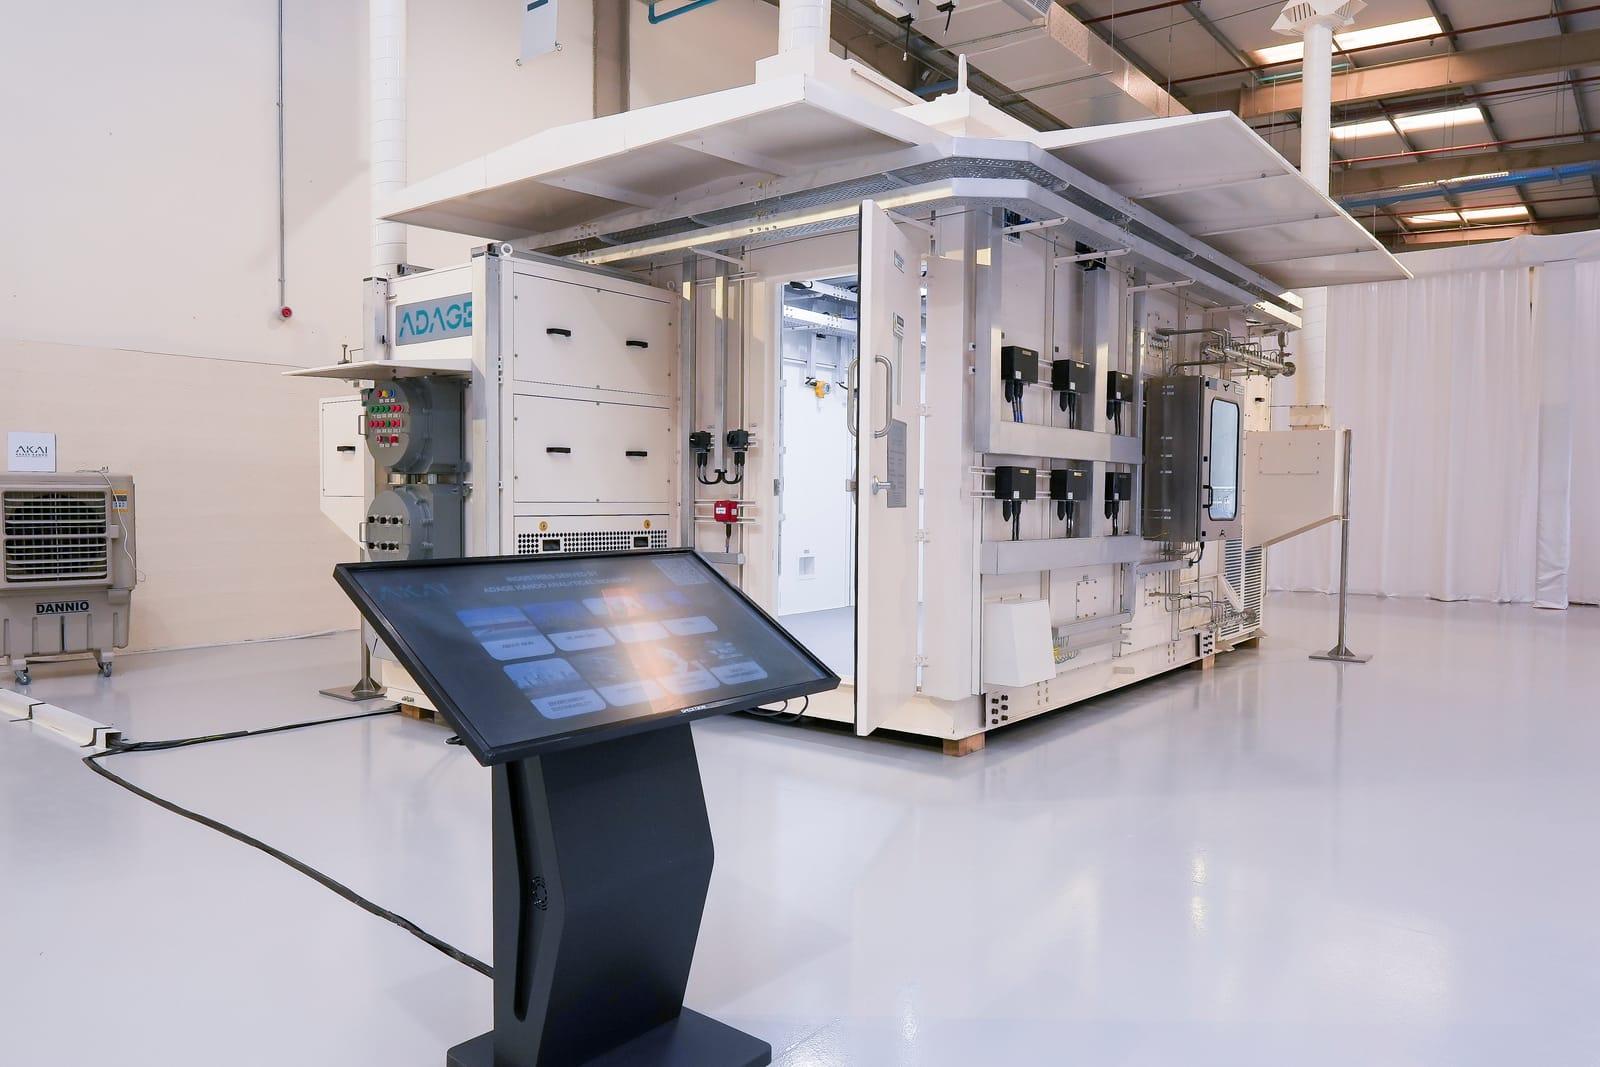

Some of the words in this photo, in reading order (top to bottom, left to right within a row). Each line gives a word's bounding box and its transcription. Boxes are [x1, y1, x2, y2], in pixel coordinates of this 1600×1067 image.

[399, 301, 473, 338] ADAGE
[15, 445, 48, 454] AKAI
[36, 601, 89, 614] DANNIO
